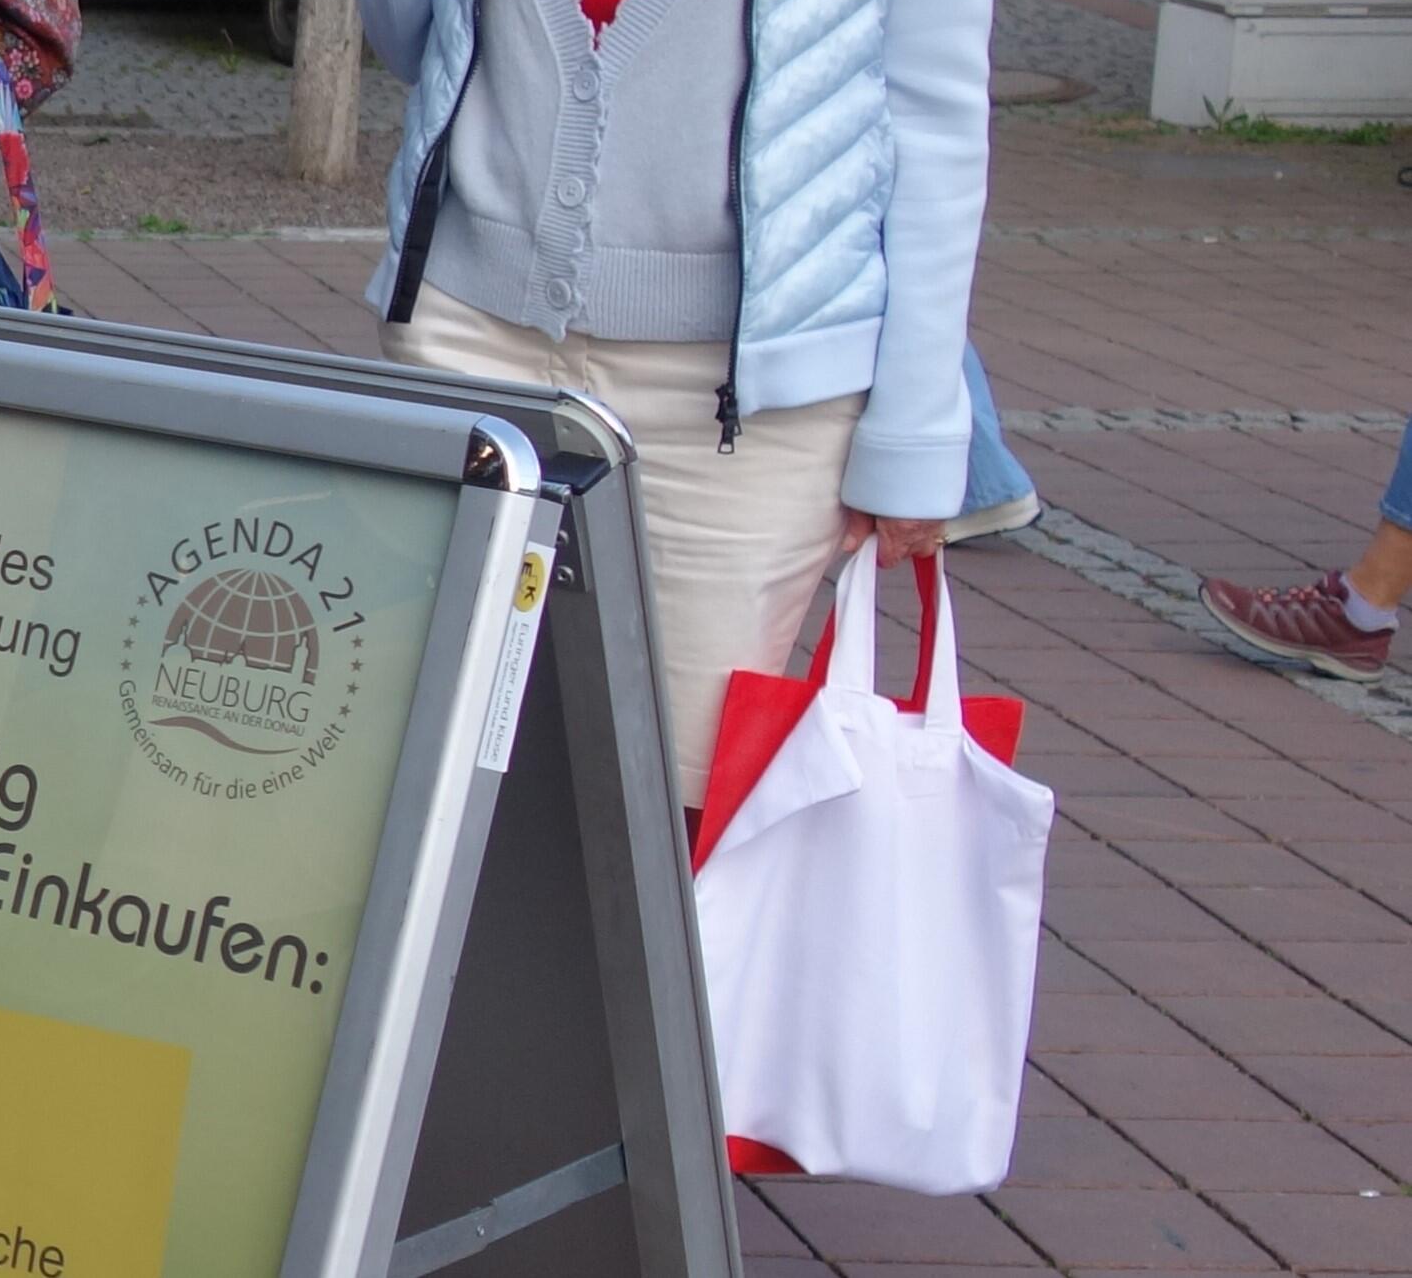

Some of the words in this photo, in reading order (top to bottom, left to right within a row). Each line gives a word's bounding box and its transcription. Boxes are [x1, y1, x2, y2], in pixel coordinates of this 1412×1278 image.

[146, 517, 323, 606] AGENDA
[319, 576, 366, 632] 21
[152, 695, 223, 720] RENAISSANCE
[223, 710, 241, 722] AN
[242, 714, 263, 728] DER
[264, 720, 306, 737] DONAU
[154, 663, 313, 722] NEUBURG
[119, 680, 189, 786] Gemeinsam
[192, 772, 221, 799] für
[226, 778, 257, 800] die
[263, 764, 304, 796] eine
[301, 722, 345, 768] Welt
